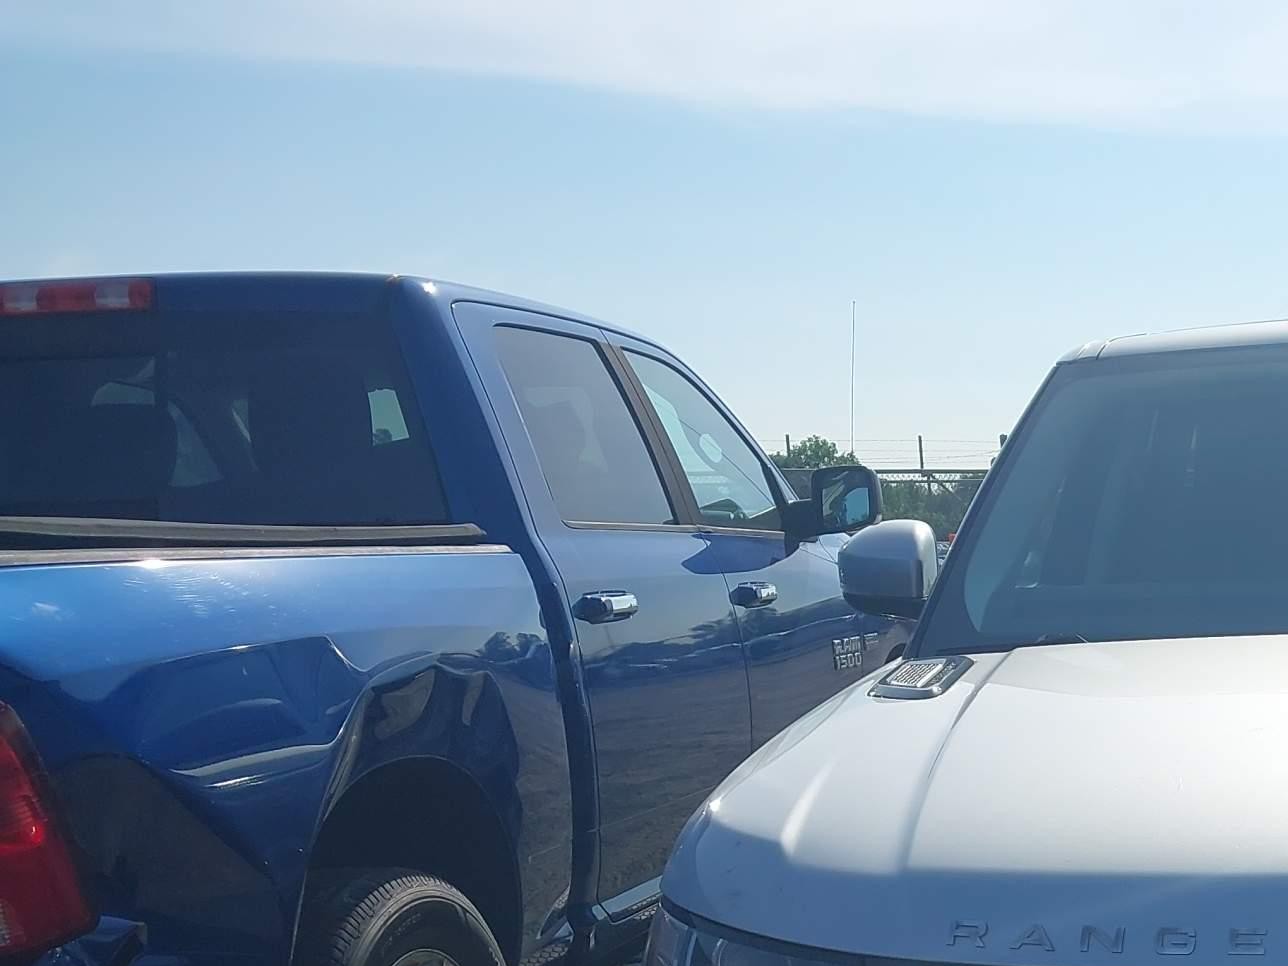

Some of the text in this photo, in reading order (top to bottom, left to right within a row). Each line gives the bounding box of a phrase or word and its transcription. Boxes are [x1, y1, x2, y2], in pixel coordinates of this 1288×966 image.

[832, 636, 861, 655] RAM
[833, 652, 862, 671] 1500
[945, 918, 1269, 956] RANGE
